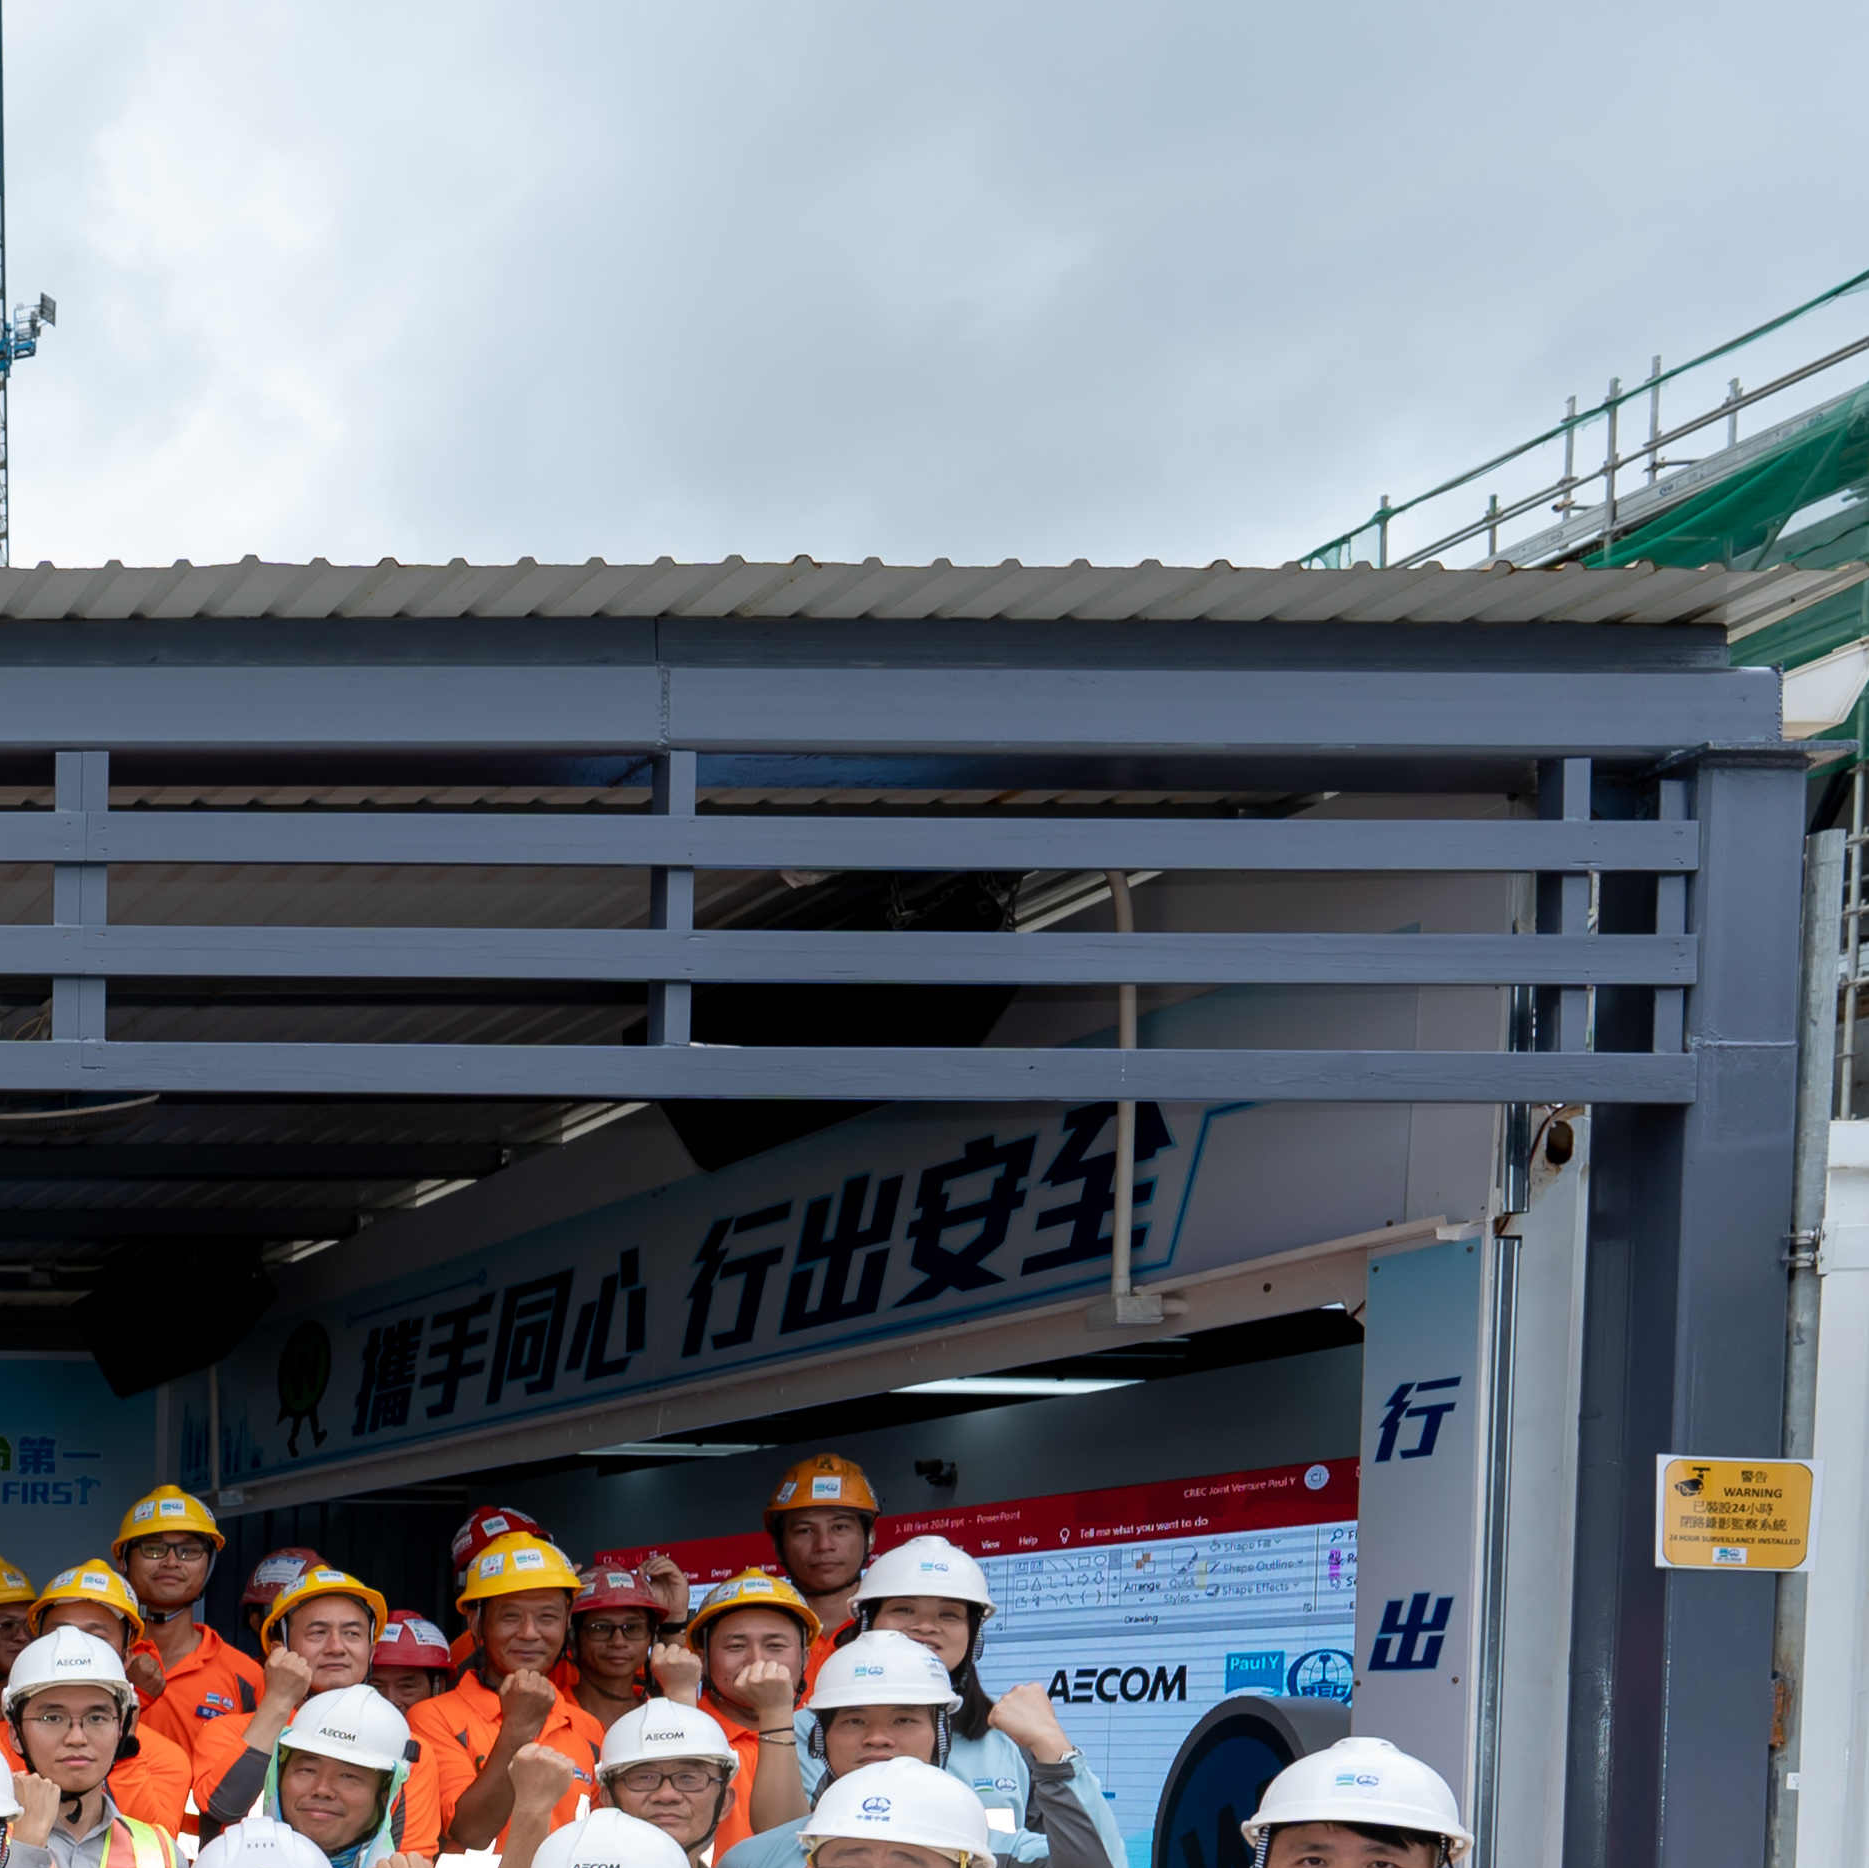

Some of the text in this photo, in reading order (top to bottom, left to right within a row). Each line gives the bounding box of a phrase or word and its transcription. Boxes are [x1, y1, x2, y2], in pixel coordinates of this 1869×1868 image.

[352, 1100, 1173, 1441] 攜手同心 行出安全
[1741, 1470, 1768, 1483] 警告
[1209, 1484, 1229, 1496] Joint
[1231, 1481, 1266, 1493] Venture
[1723, 1487, 1782, 1498] WARNING
[977, 1511, 1021, 1524] PowerPoint
[1080, 1528, 1094, 1539] Tell
[1113, 1525, 1134, 1536] what
[1136, 1523, 1154, 1535] you
[1156, 1519, 1179, 1531] want
[1181, 1518, 1191, 1527] to
[1194, 1515, 1208, 1526] do
[981, 1539, 1000, 1549] View
[1019, 1536, 1038, 1546] Help
[1702, 1535, 1755, 1545] SURVEILLANCE
[1758, 1537, 1800, 1546] INSTALLED
[1223, 1563, 1254, 1574] Shape
[1124, 1581, 1161, 1593] Arrange
[1169, 1578, 1195, 1589] Quick
[1222, 1582, 1289, 1597] Shape Effects
[1164, 1592, 1190, 1604] Styles
[1124, 1613, 1158, 1625] Drawing
[56, 1658, 92, 1667] AECOM
[1230, 1656, 1266, 1671] Paul
[1047, 1665, 1187, 1703] AECOM
[319, 1727, 357, 1742] AECOM
[645, 1732, 685, 1742] AECOM
